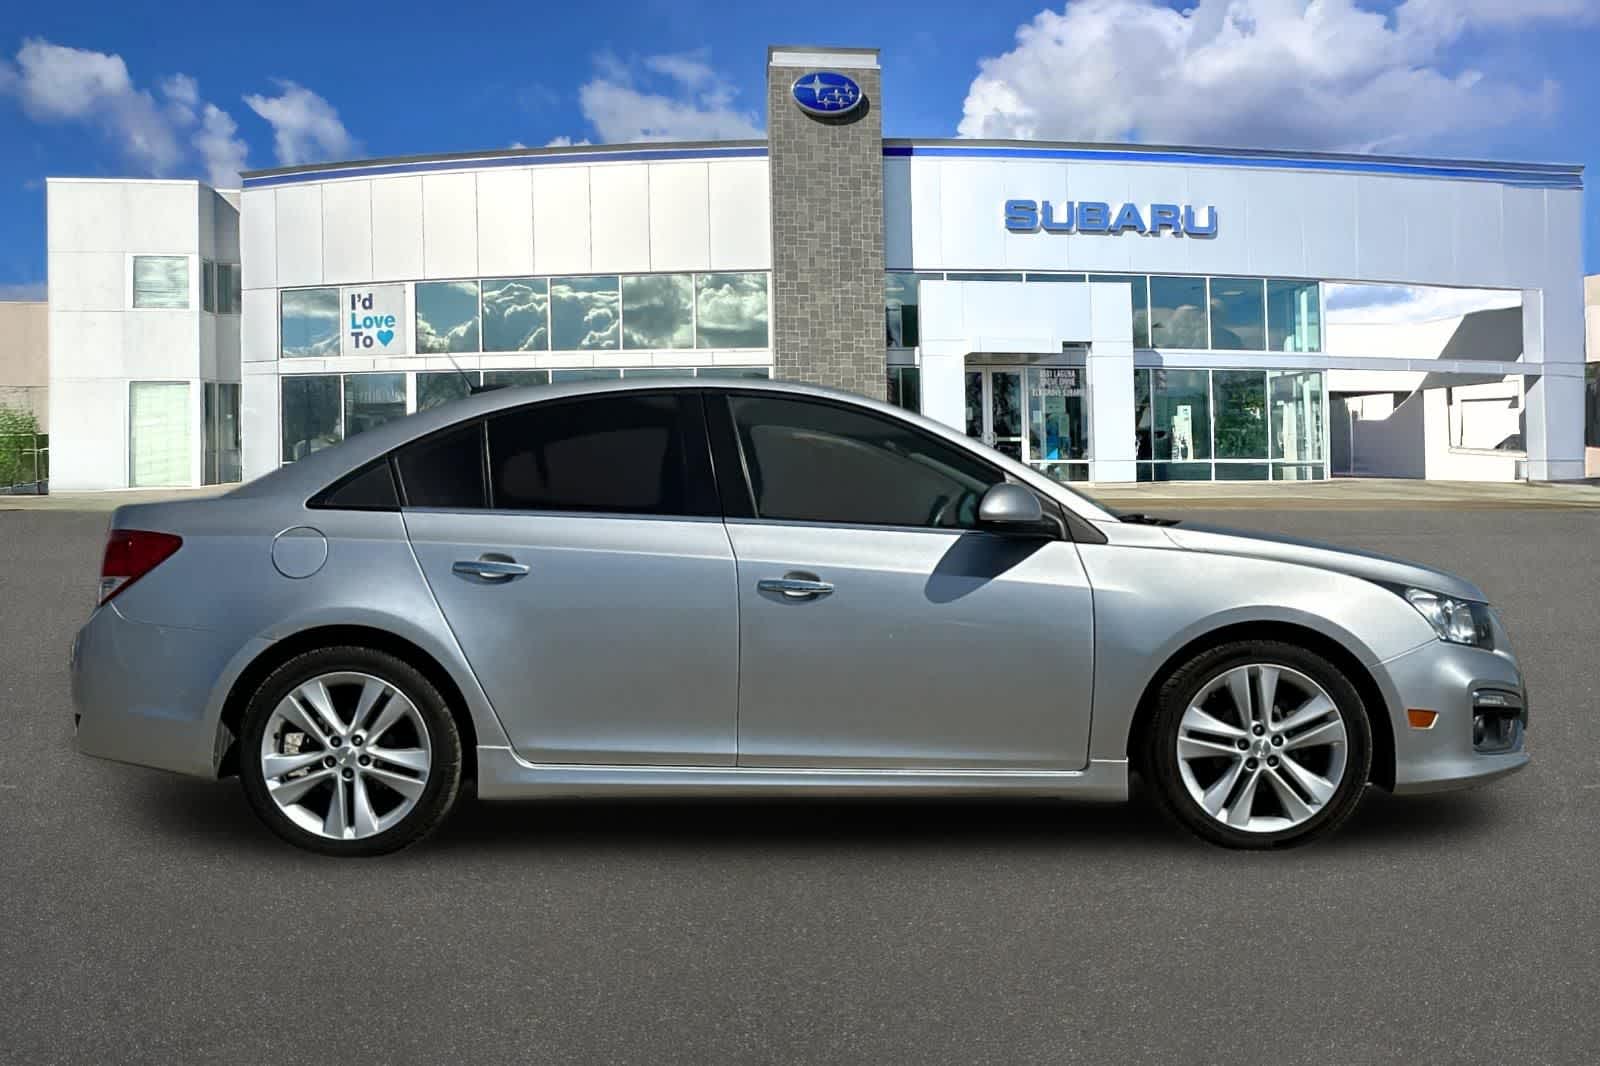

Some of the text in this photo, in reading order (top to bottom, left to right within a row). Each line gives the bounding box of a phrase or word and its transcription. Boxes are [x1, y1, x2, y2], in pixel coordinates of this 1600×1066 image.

[1004, 199, 1218, 239] SUBARU
[351, 293, 373, 310] I'd
[351, 312, 396, 330] Love
[351, 331, 374, 348] To
